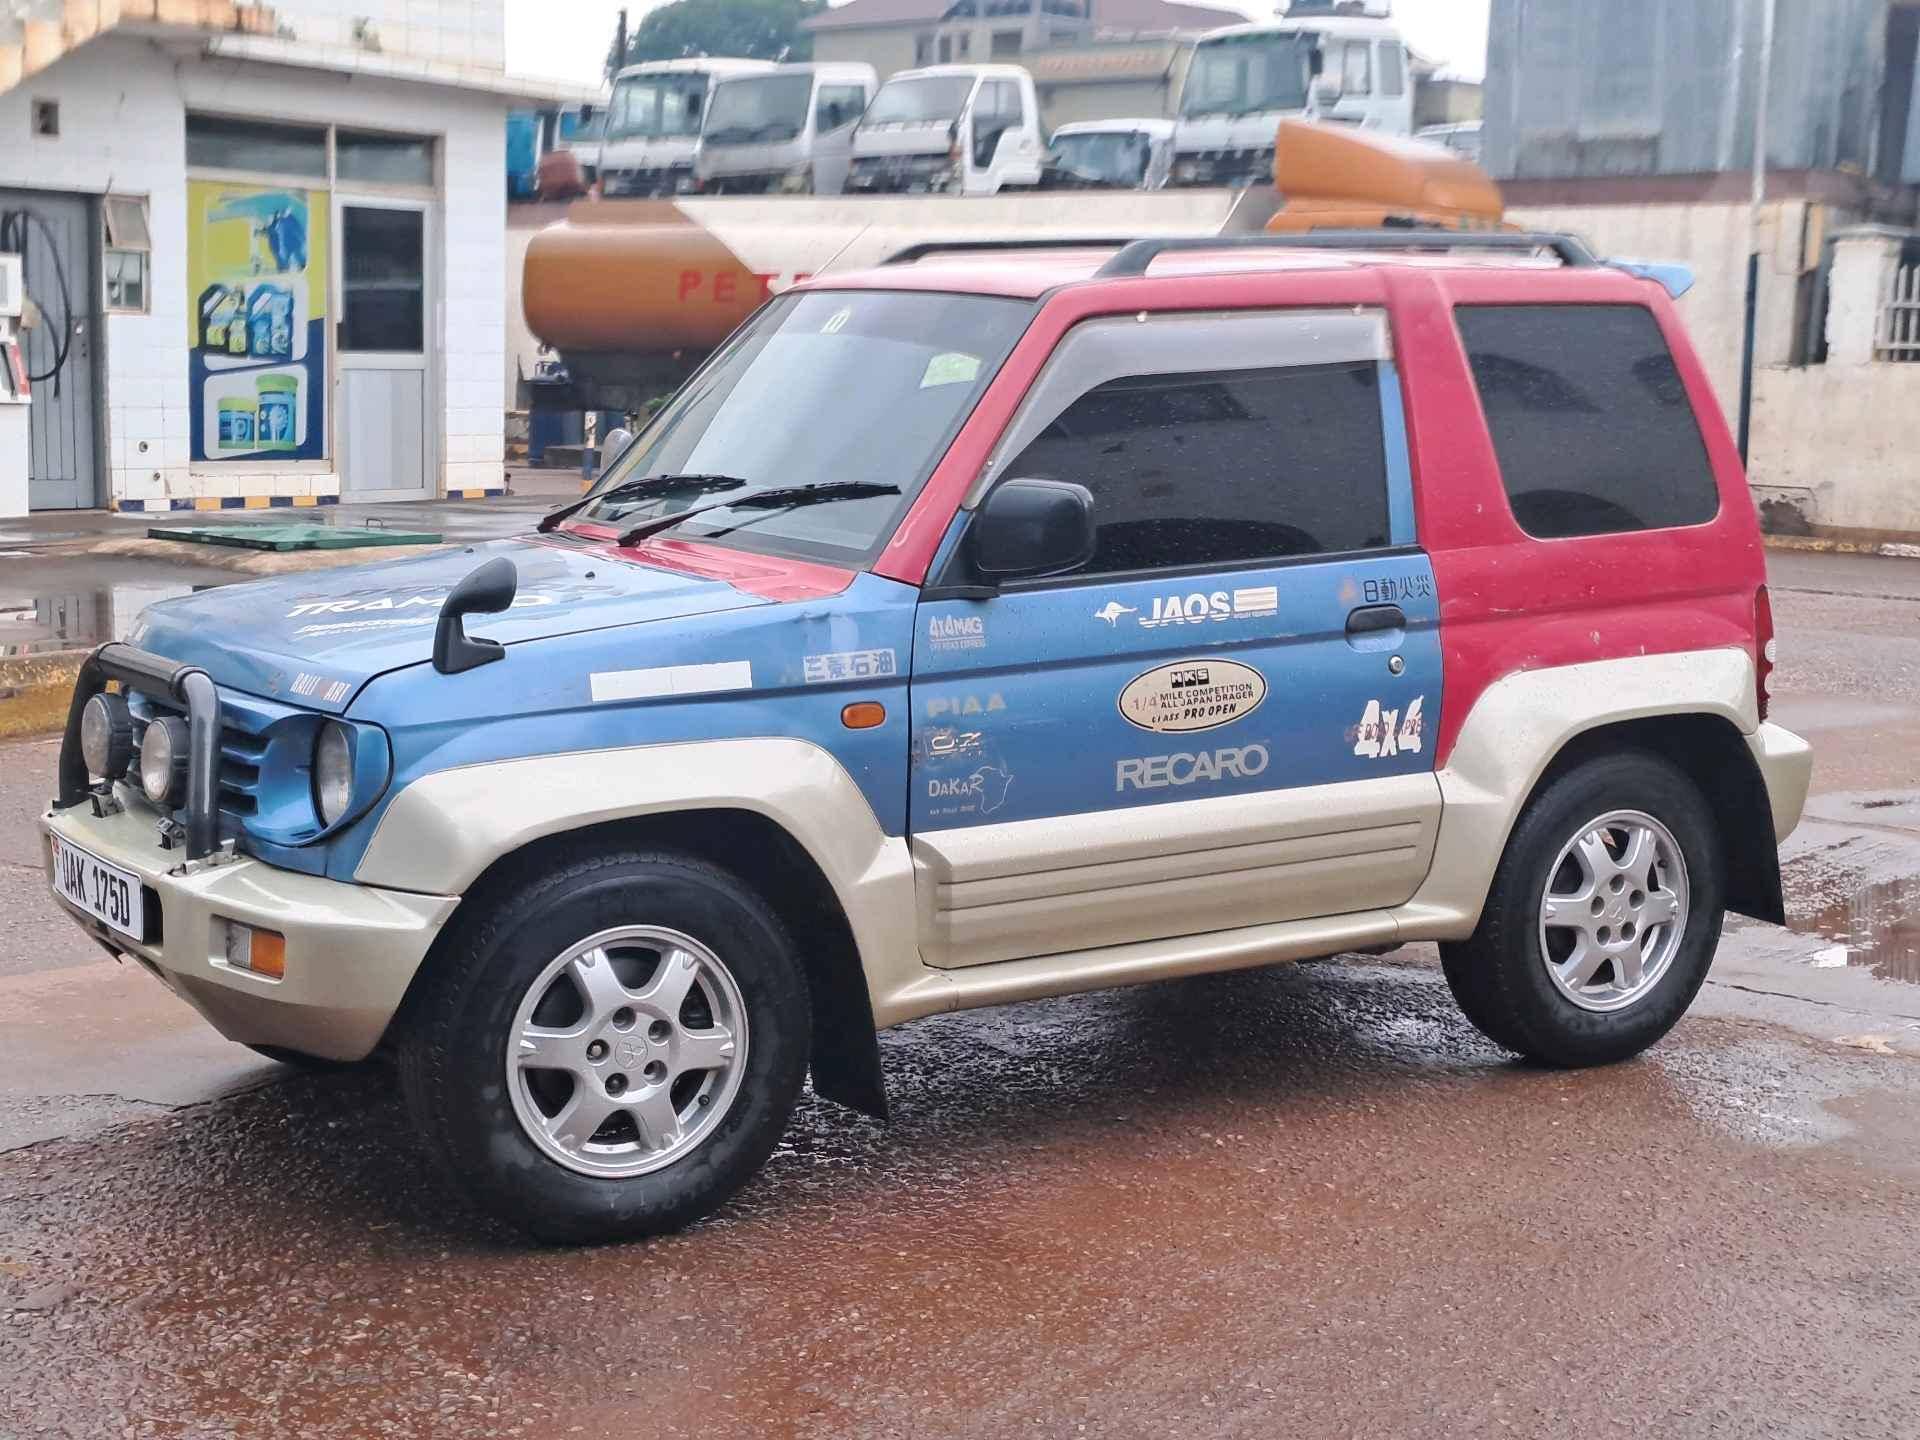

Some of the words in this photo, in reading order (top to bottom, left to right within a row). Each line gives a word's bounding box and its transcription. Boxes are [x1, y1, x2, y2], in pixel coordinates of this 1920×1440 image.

[677, 271, 812, 303] PET
[1363, 576, 1431, 602] 日動火災
[1138, 590, 1231, 627] JAOS
[1171, 669, 1209, 687] HKS
[1160, 691, 1183, 701] MILE
[1186, 682, 1252, 698] COMPETITION
[1161, 699, 1178, 709] ALL
[1180, 696, 1213, 707] JAPAN
[1215, 691, 1254, 703] DRAGER
[928, 692, 1007, 717] PIAA
[1184, 707, 1204, 720] PRO
[1208, 703, 1236, 717] OPEN
[1116, 744, 1269, 792] RECARO
[61, 847, 87, 904] UAK
[93, 864, 130, 927] 175D
